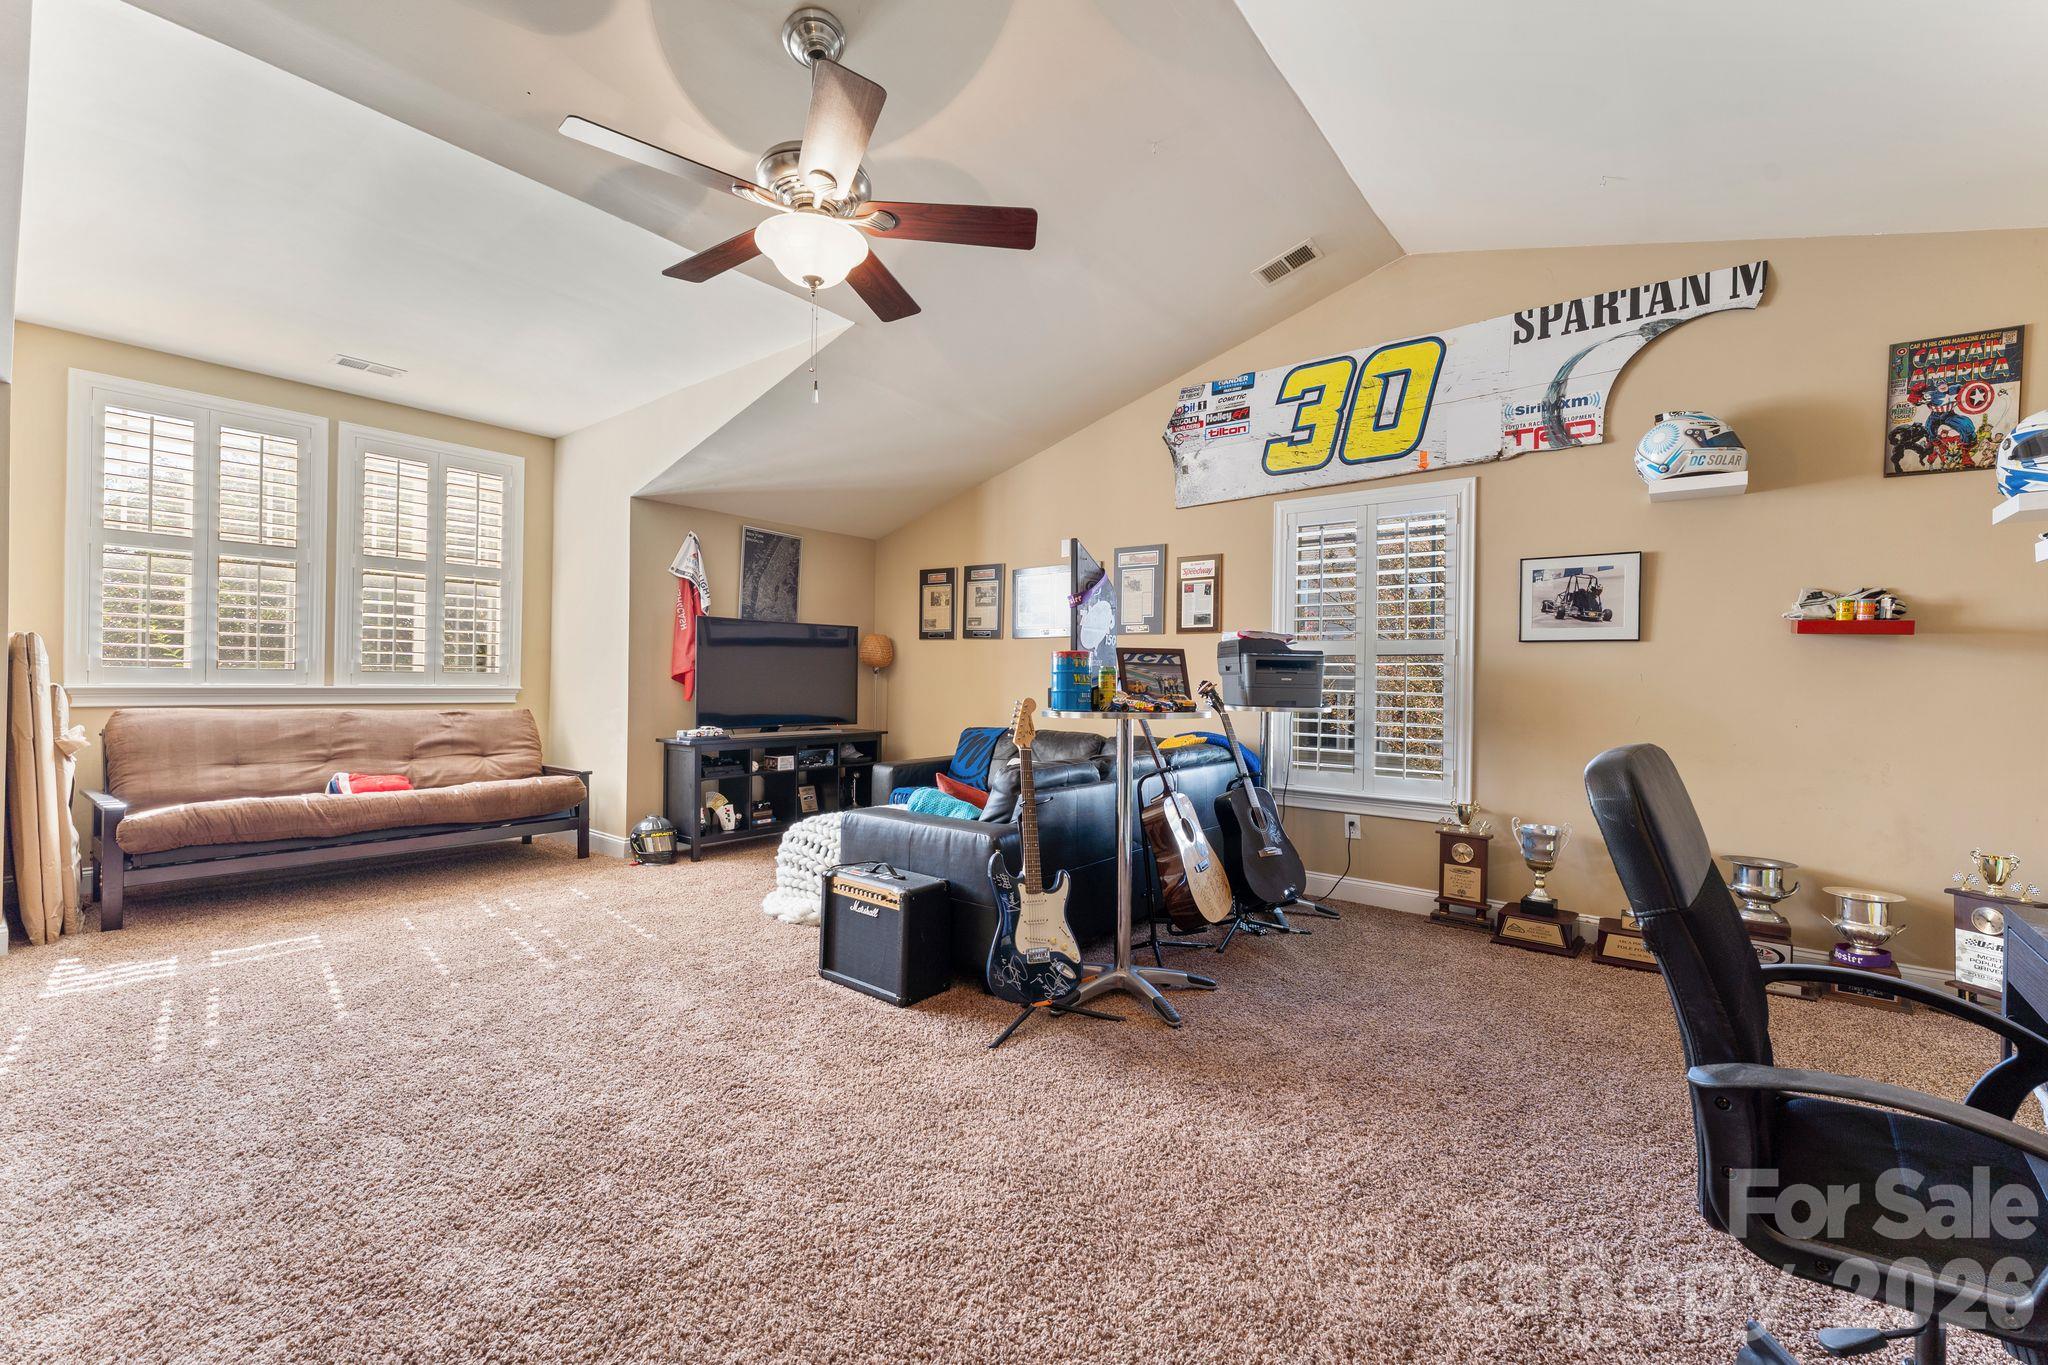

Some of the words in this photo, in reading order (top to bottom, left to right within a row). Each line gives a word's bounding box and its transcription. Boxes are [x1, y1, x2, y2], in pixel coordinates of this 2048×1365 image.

[1513, 272, 1711, 345] SPARTAN
[1912, 339, 2007, 368] CAPTAIN
[1907, 357, 2012, 389] AMERICA
[1176, 402, 1195, 415] obil
[1262, 336, 1447, 476] 30
[1208, 425, 1247, 438] tilton
[1505, 422, 1526, 430] TOYOTA
[1707, 454, 1743, 467] SOLAR
[1182, 567, 1213, 577] Speedway
[850, 900, 880, 918] Marshall
[1969, 957, 2003, 970] POPULA
